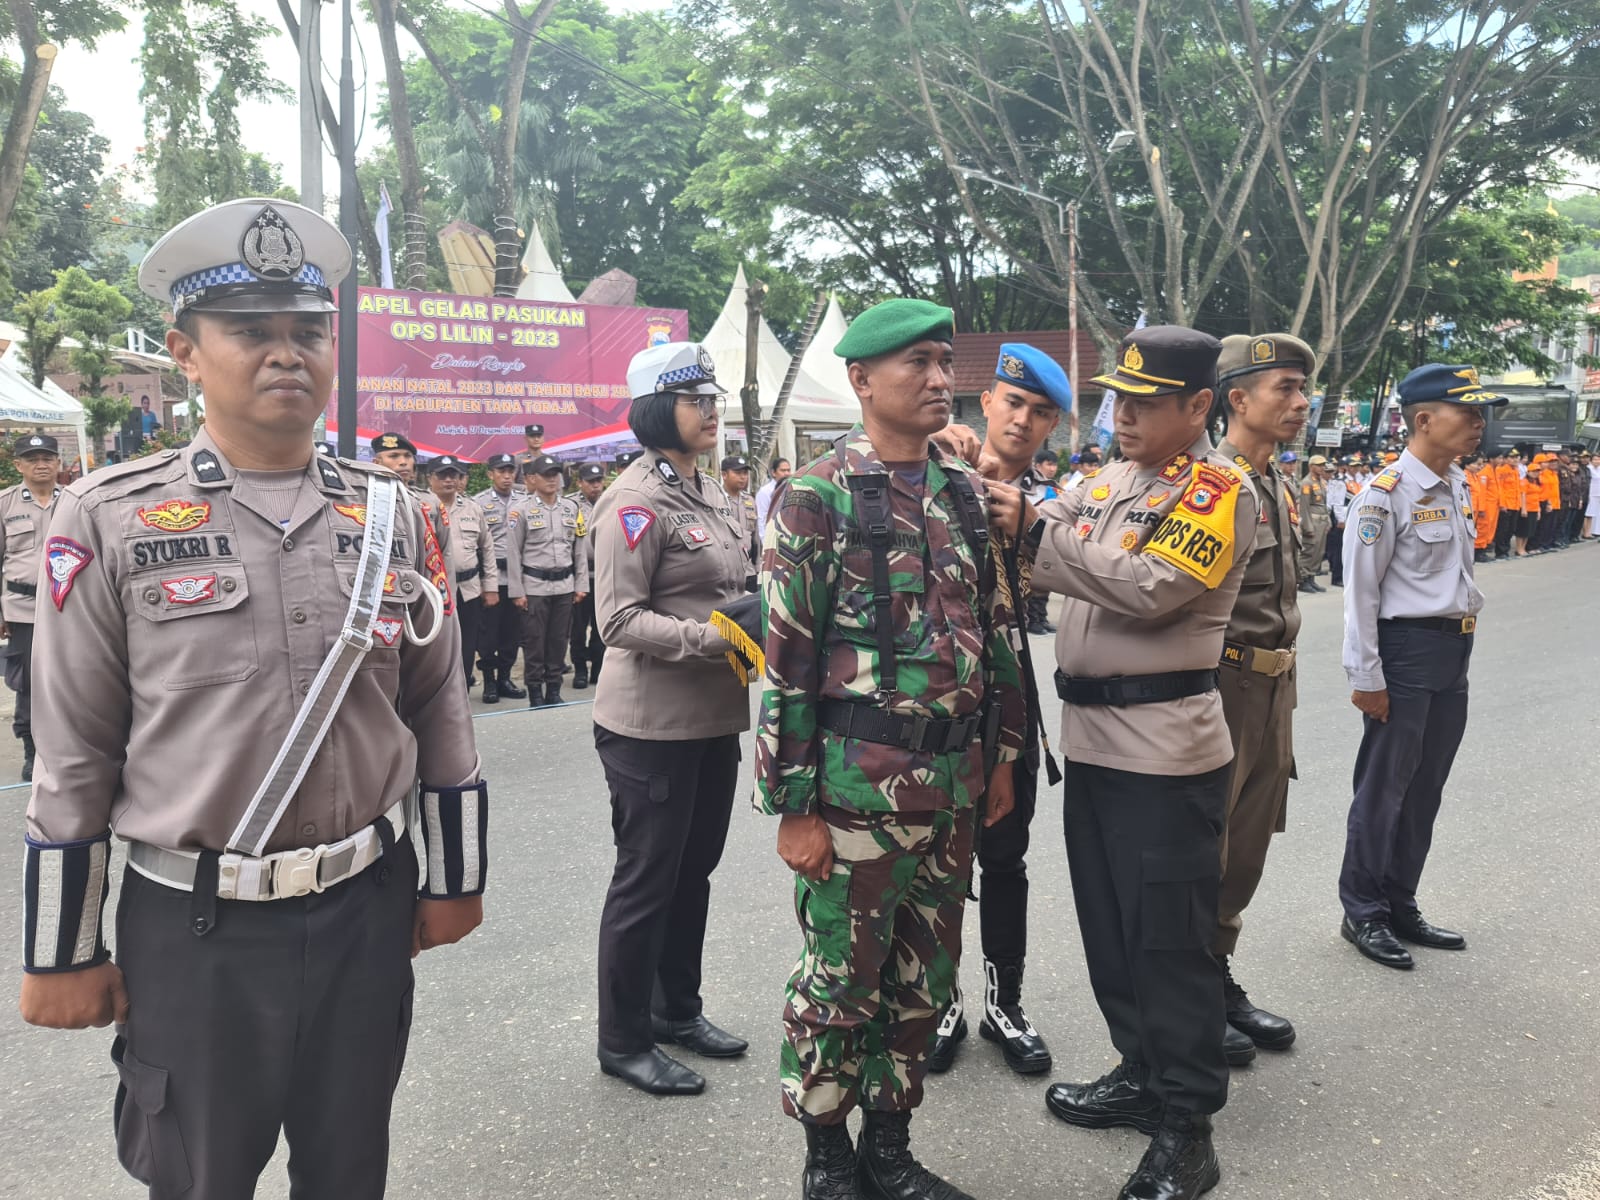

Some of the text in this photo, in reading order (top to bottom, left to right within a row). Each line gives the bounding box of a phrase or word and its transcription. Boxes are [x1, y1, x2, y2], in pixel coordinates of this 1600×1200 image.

[359, 295, 585, 327] APEL GELAR PASUKAN
[391, 322, 437, 341] OPS
[441, 324, 493, 345] LILIN
[511, 330, 560, 348] 2023
[404, 378, 456, 395] NATAL
[457, 380, 493, 396] 2023
[494, 381, 525, 397] DAN
[525, 382, 573, 398] TAHUN
[573, 384, 610, 399] BARU
[374, 396, 579, 415] DI KABUPATEN TANA TORAJA
[1416, 511, 1443, 521] ORBA
[134, 535, 232, 566] SYUKRI R
[336, 532, 406, 558] PORI
[1153, 518, 1222, 568] OPS RES
